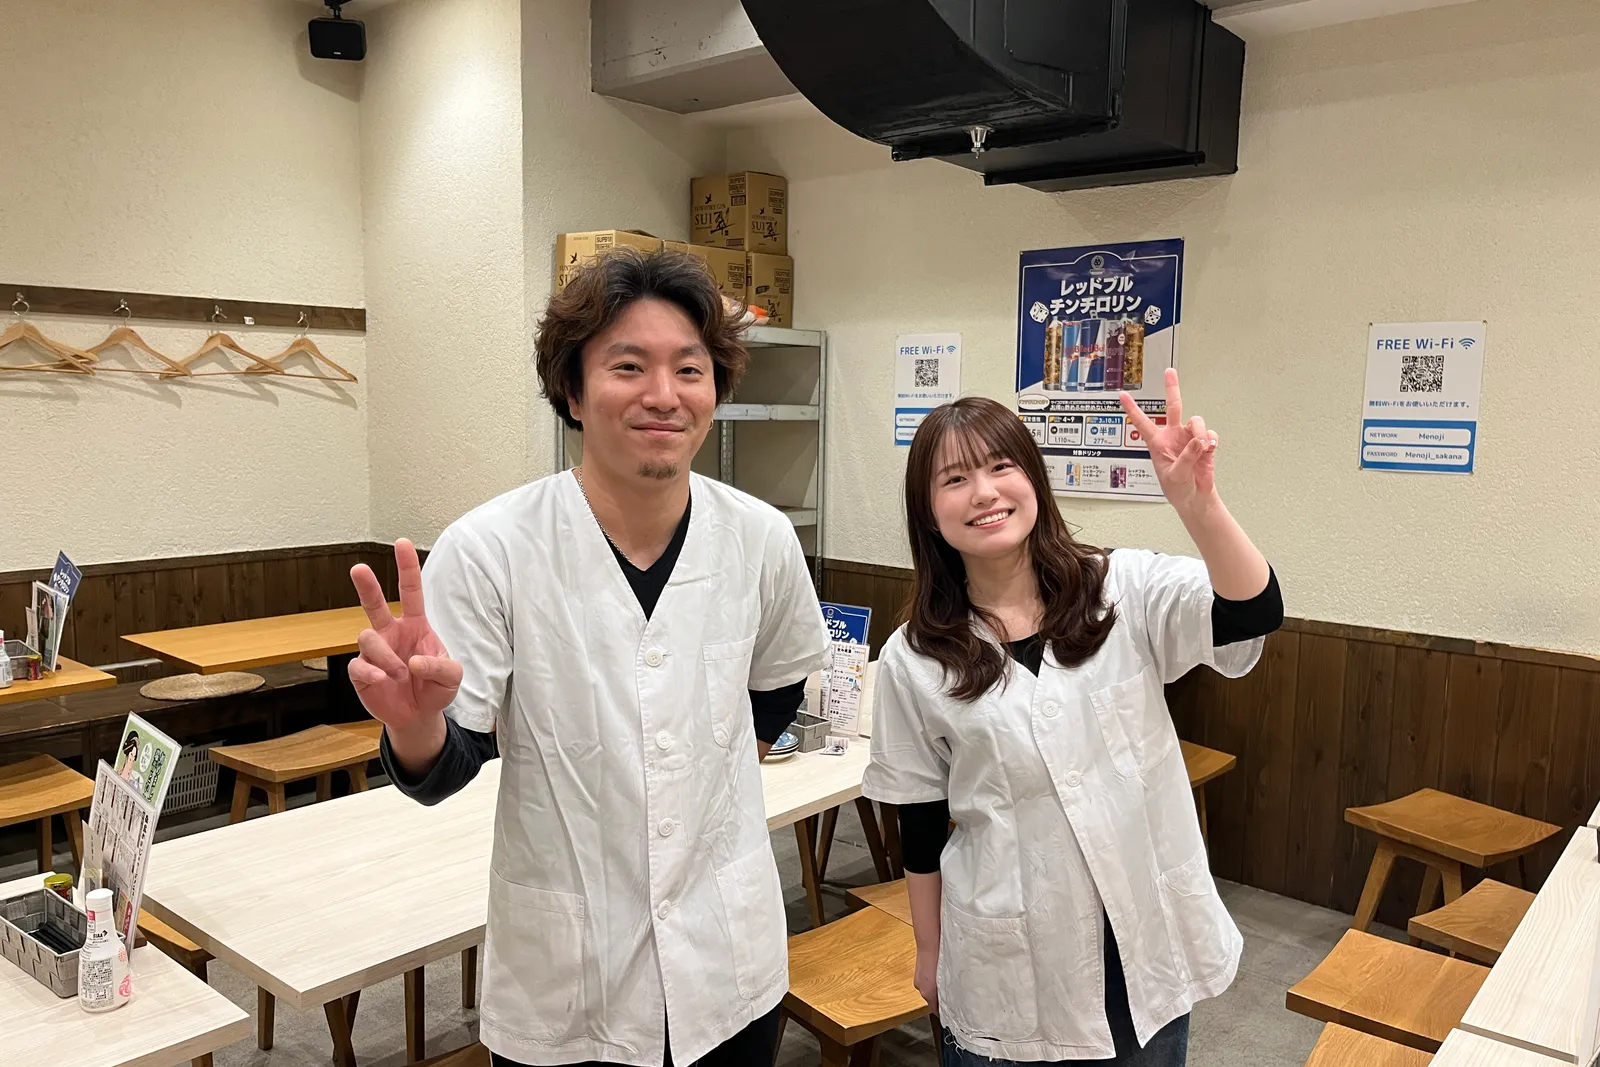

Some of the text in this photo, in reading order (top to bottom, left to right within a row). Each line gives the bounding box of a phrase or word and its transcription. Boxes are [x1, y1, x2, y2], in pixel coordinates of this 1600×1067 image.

[695, 213, 711, 225] SUI
[752, 221, 764, 230] SUI
[1060, 275, 1133, 296] レッドブル
[1050, 294, 1142, 315] チンチロリン
[1376, 337, 1454, 350] FREE Wi-Fi
[900, 345, 944, 355] FREE Wi-Fi
[1418, 433, 1445, 441] Menoji
[1405, 451, 1463, 461] Menoji_sakana
